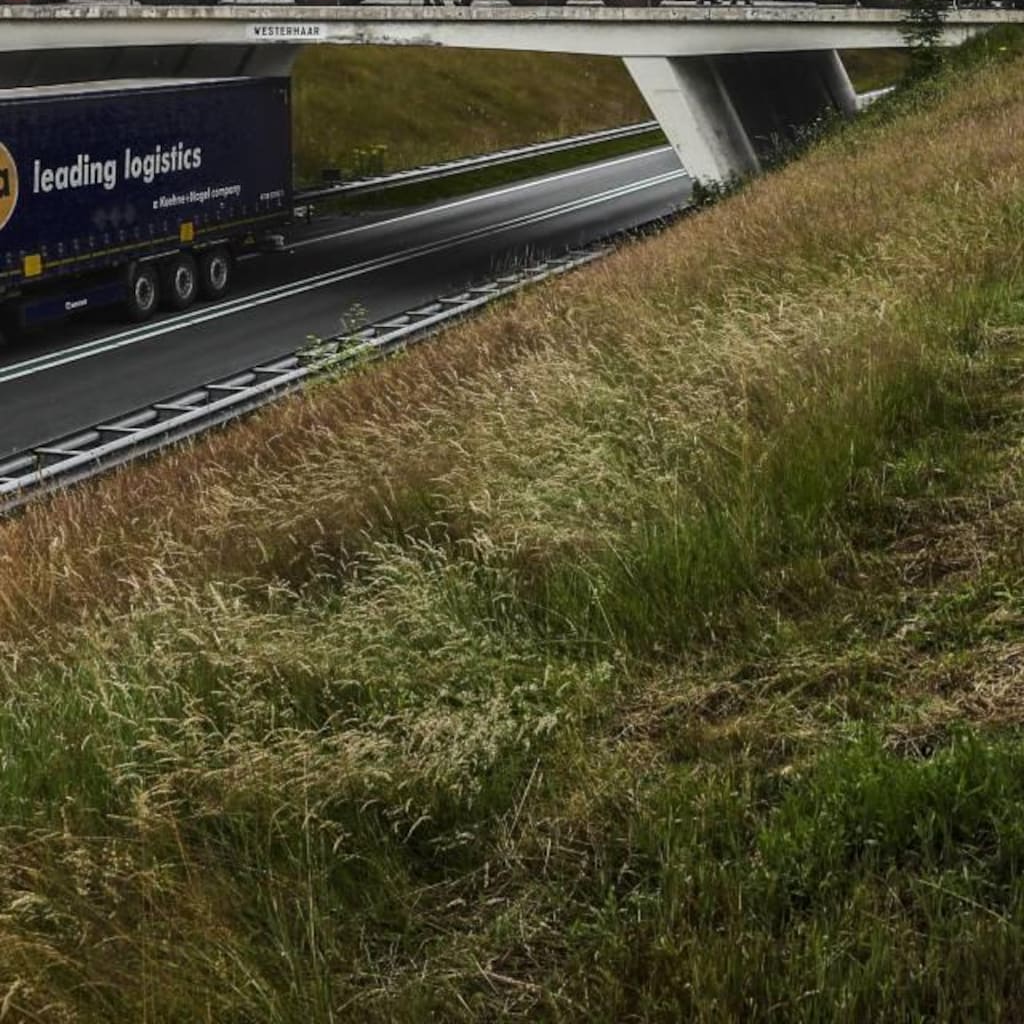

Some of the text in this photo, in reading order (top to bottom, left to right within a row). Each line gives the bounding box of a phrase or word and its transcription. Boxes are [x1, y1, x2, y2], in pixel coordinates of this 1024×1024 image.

[254, 25, 320, 36] WESTERHAAR
[33, 142, 202, 193] leading logistics
[211, 185, 241, 198] company
